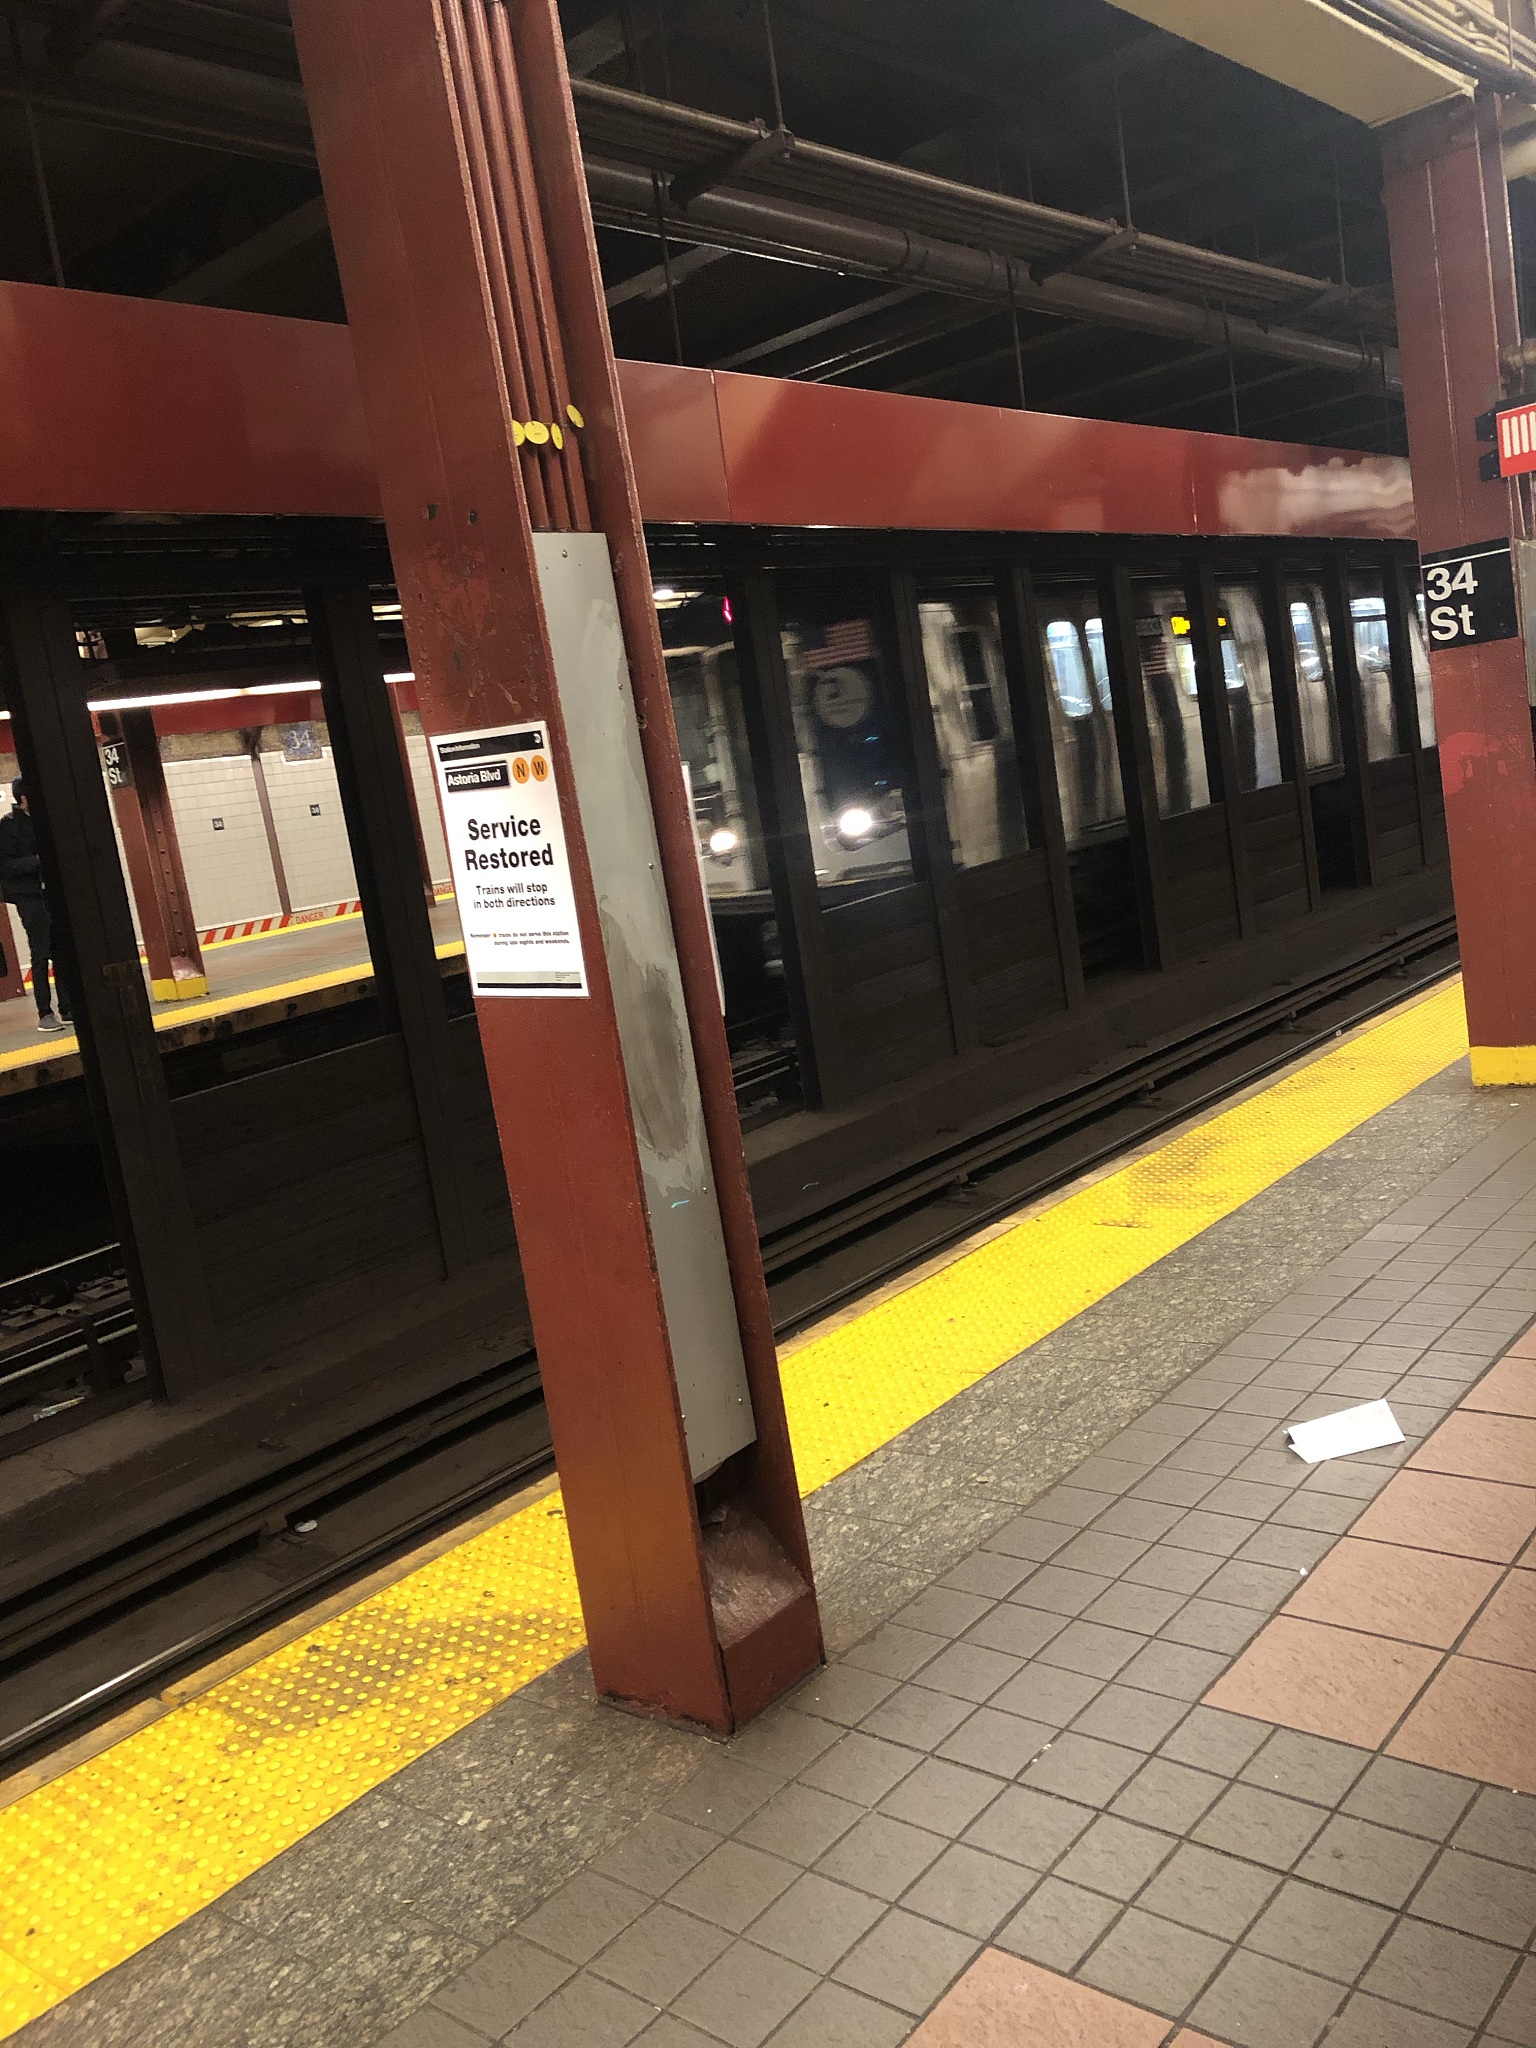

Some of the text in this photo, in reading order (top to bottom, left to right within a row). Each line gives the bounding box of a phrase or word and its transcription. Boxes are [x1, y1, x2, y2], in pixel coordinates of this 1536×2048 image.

[1426, 562, 1478, 601] 34
[1430, 603, 1476, 641] St
[289, 730, 312, 749] 34
[104, 747, 120, 766] 34
[109, 768, 123, 785] St
[447, 769, 501, 786] Astoria Blvd
[516, 761, 544, 778] N W
[467, 815, 541, 841] Service
[464, 843, 554, 871] Restored
[476, 882, 548, 896] Trains will stop
[473, 896, 555, 909] in both directions
[295, 911, 325, 924] DANGER
